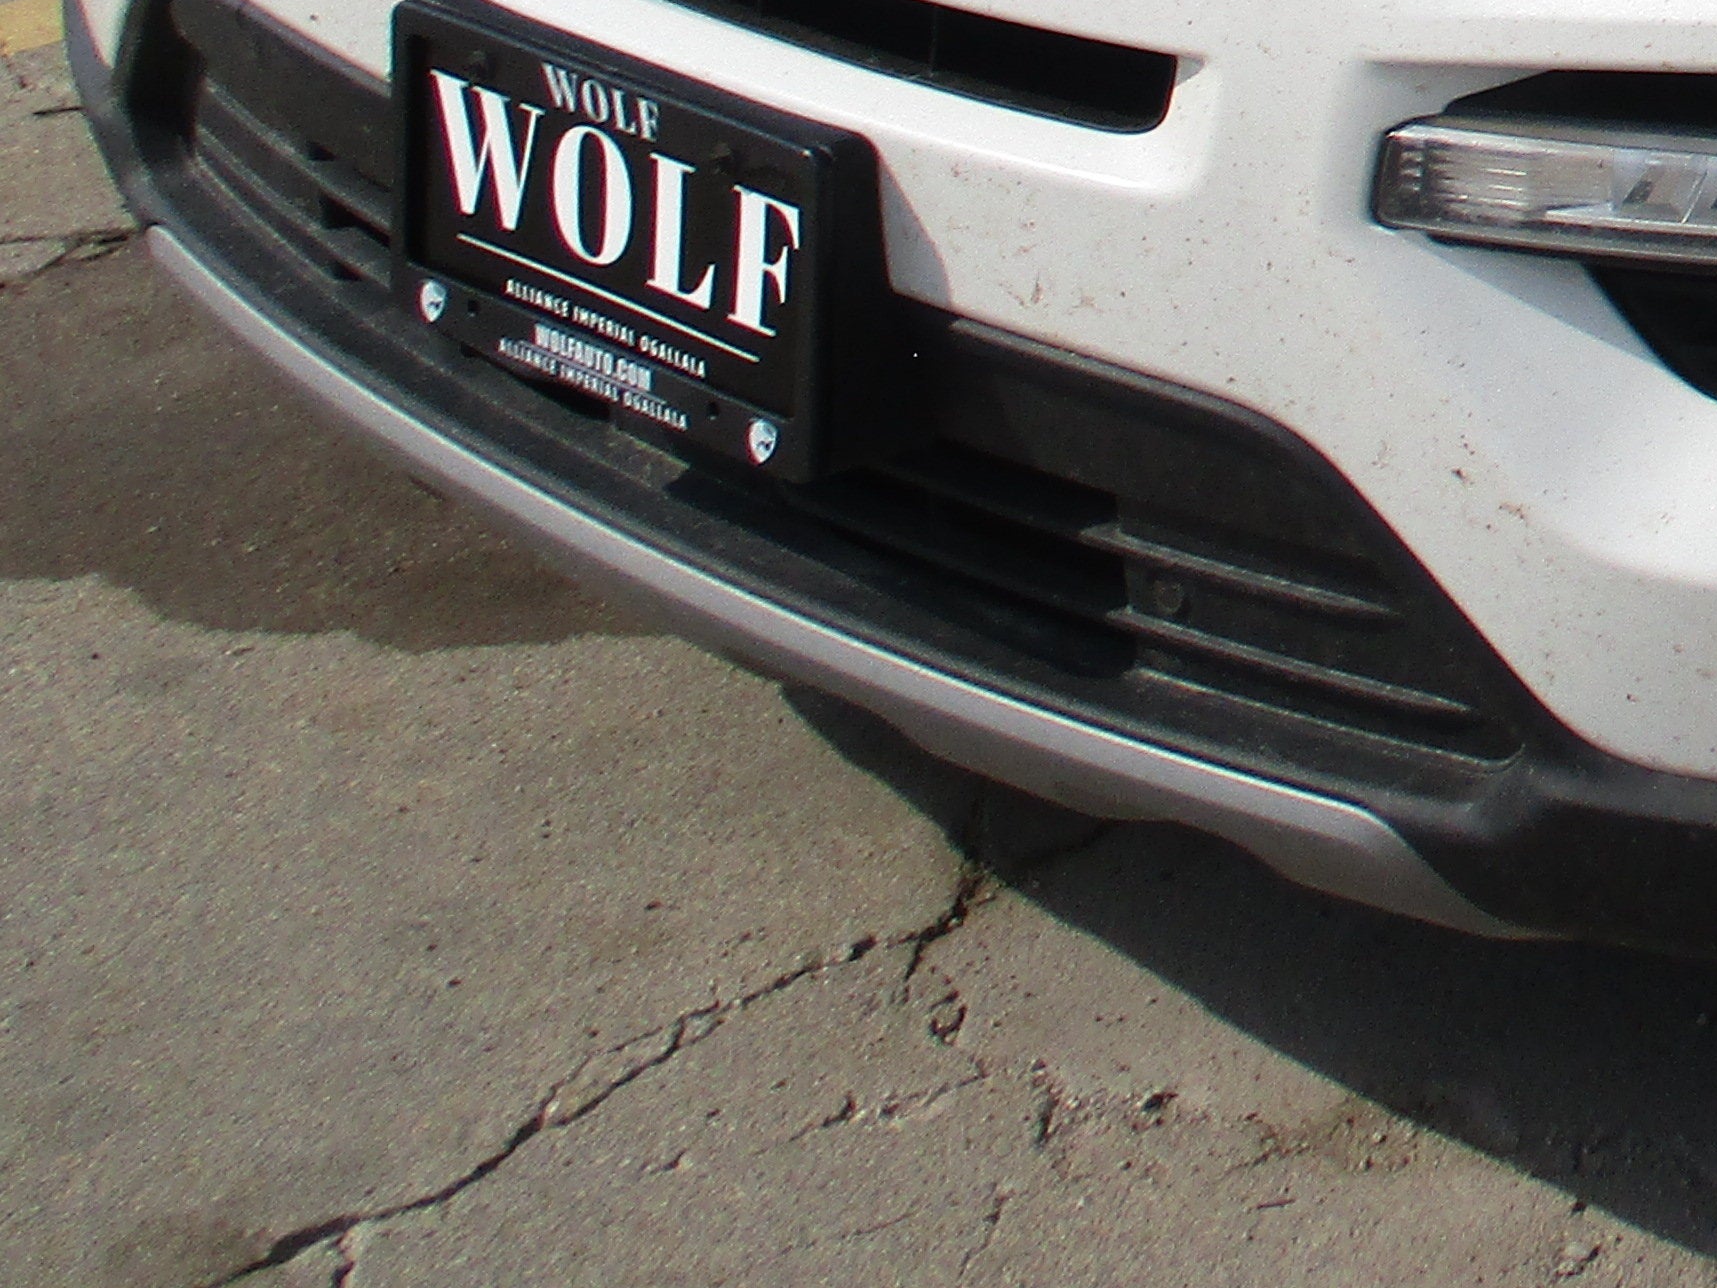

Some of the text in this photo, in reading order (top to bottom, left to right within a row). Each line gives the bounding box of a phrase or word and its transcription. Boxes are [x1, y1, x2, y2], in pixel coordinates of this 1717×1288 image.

[541, 61, 661, 141] WOLF
[428, 67, 801, 338] WOLF
[504, 278, 706, 379] ALLIANCE IMPERIAL OGALLALA
[533, 323, 653, 392] WOLFAUTO.COM
[499, 336, 689, 431] ALLIANCE IMPERIAL OGALLALA
